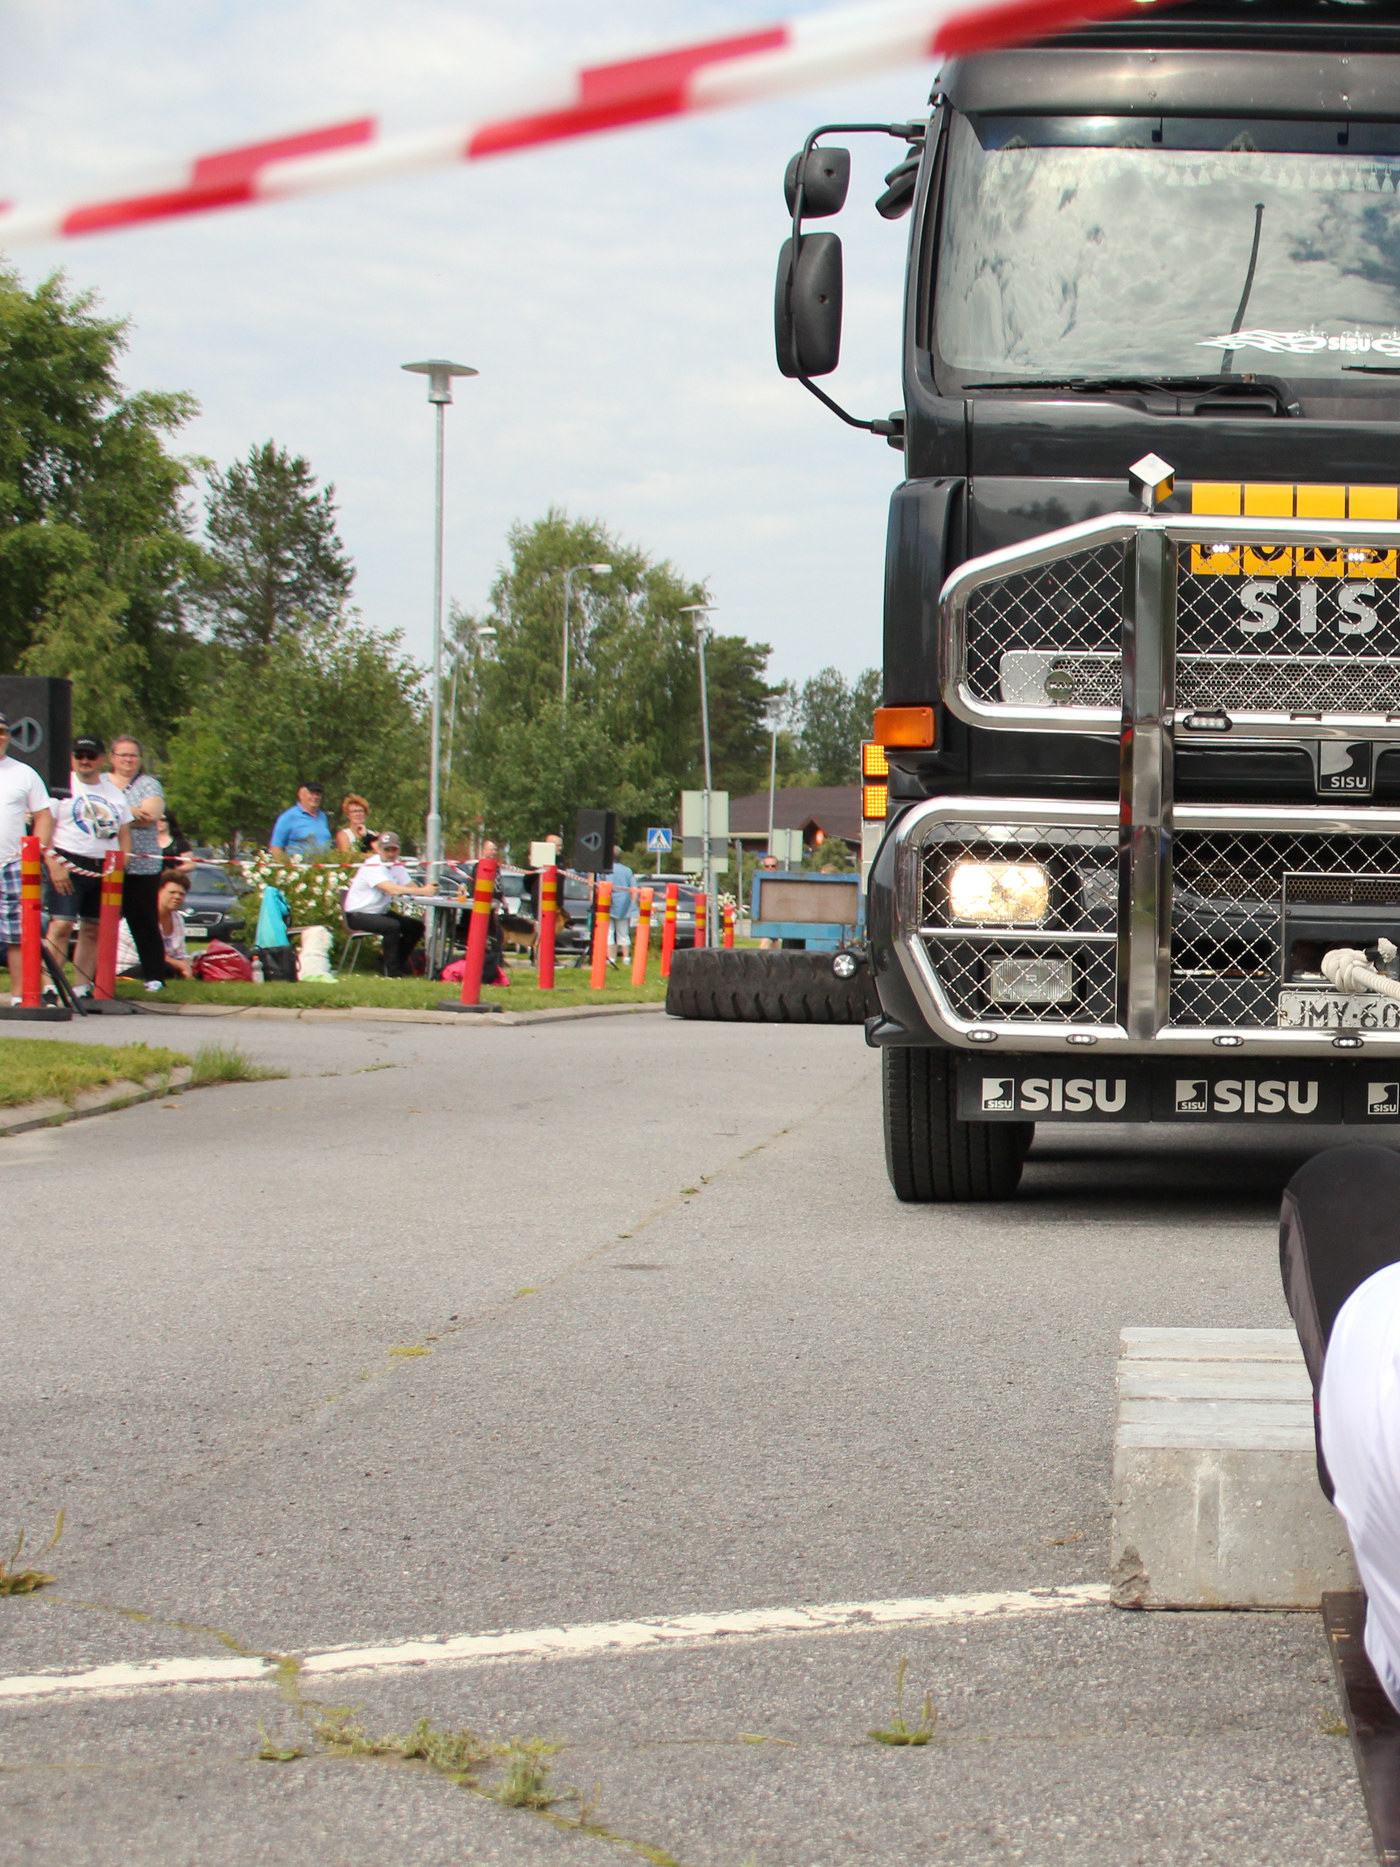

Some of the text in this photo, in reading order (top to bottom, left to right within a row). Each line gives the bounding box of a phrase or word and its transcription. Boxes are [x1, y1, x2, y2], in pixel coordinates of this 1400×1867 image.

[1328, 335, 1371, 352] SISU
[1331, 776, 1367, 788] SISU
[1020, 1078, 1127, 1112] SISU
[1214, 1080, 1319, 1114] SISU
[987, 1100, 1012, 1109] SISU
[1181, 1102, 1206, 1110] SISU
[1373, 1104, 1397, 1112] SISU
